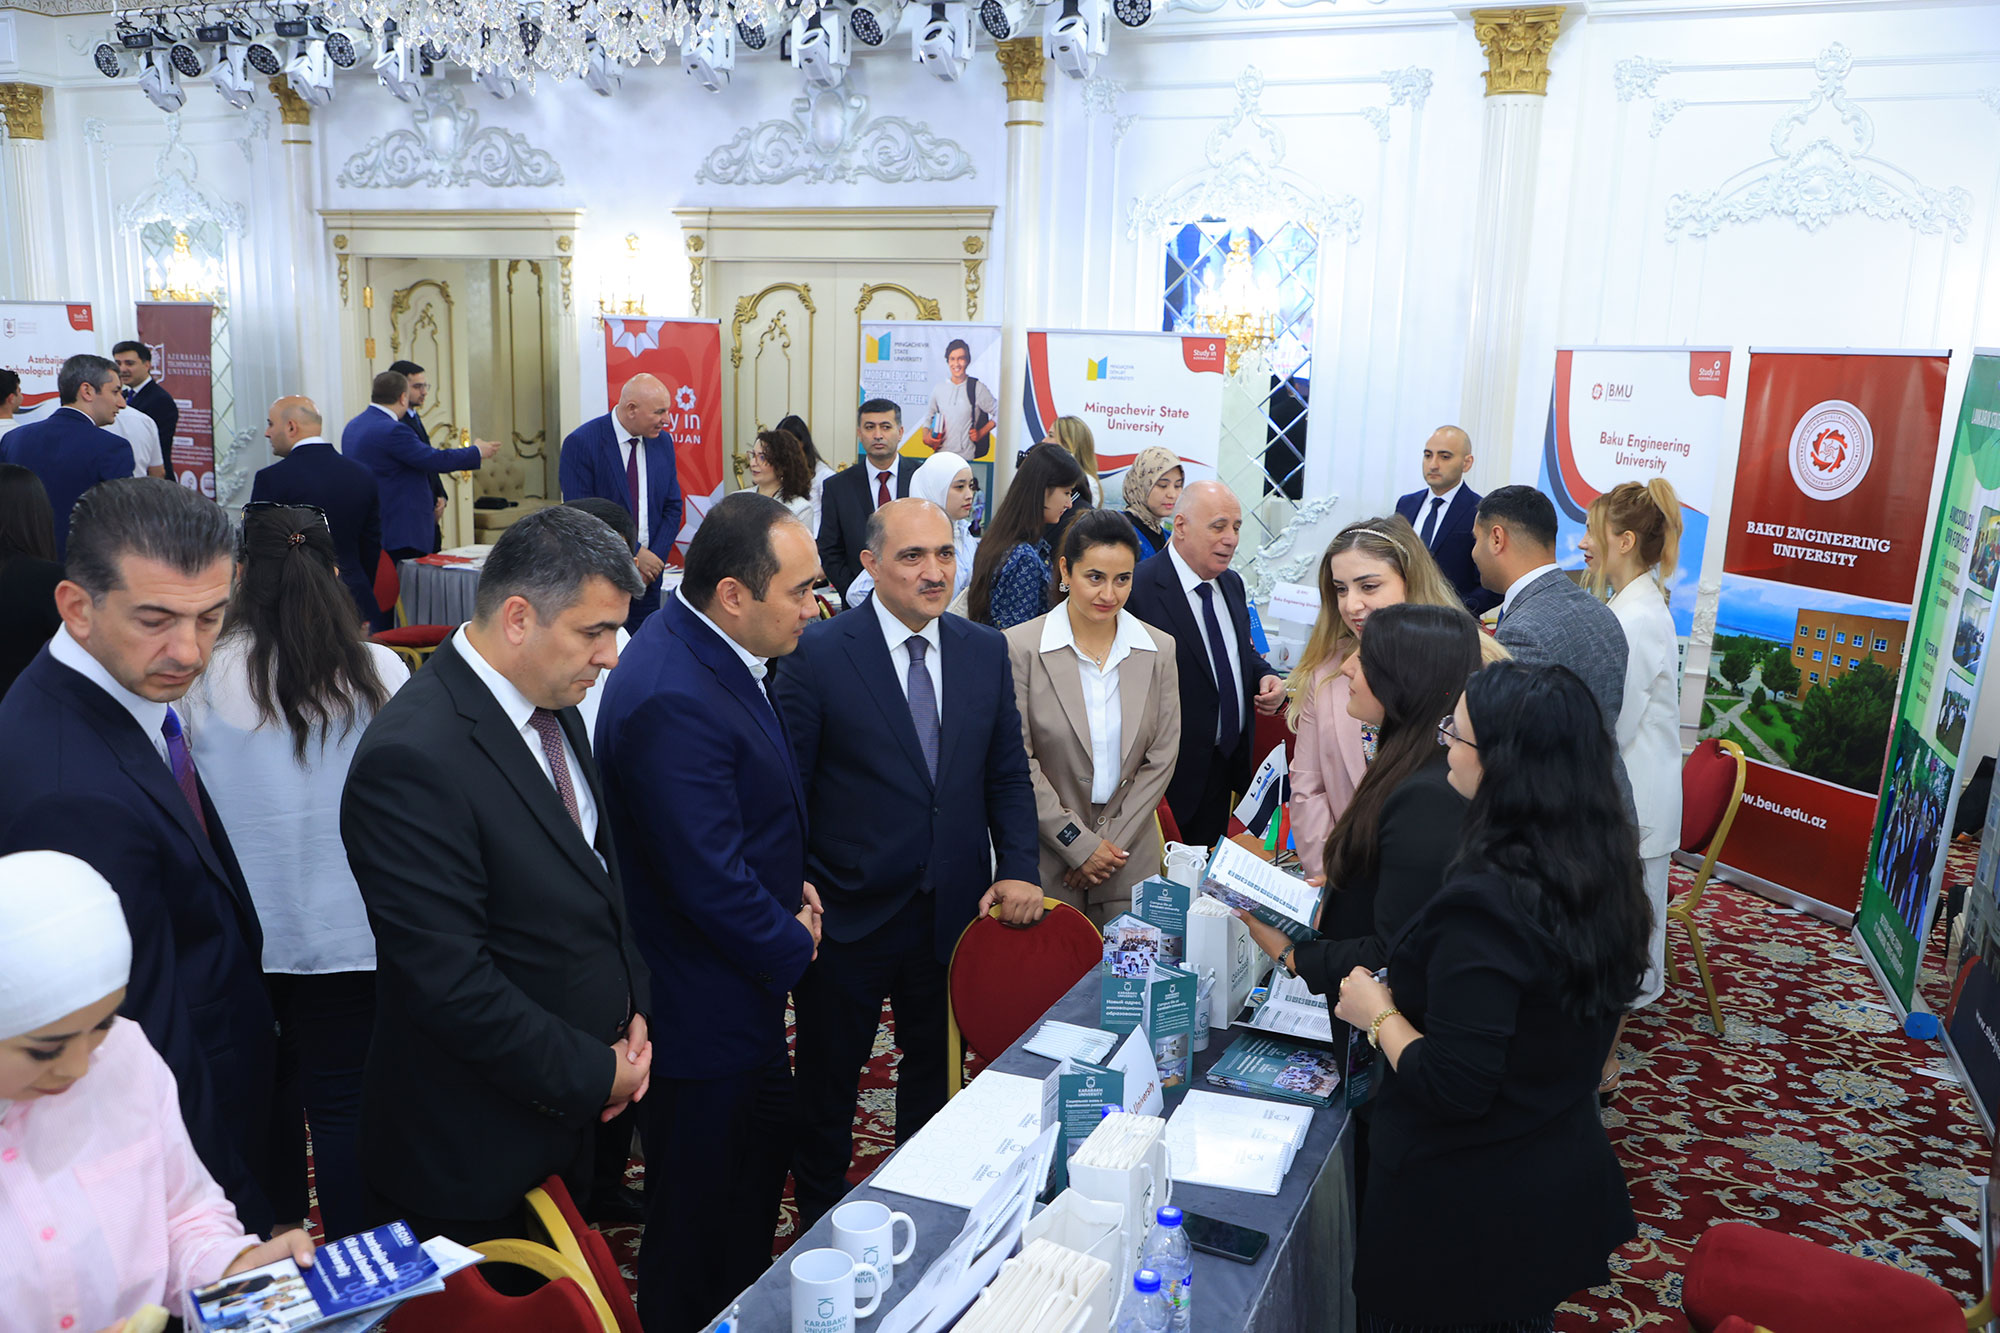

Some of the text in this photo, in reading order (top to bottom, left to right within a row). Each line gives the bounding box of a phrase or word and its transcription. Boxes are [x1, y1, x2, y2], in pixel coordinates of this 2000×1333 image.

[1608, 383, 1633, 398] BMU
[1084, 402, 1189, 419] Mingachevir State
[1107, 418, 1164, 436] University
[1600, 431, 1691, 457] Baku Engineering
[1615, 451, 1667, 473] University
[1746, 521, 1891, 553] BAKU ENGINEERING
[1773, 543, 1858, 567] UNIVERSITY
[1740, 792, 1827, 829] w.beu.edu.az
[804, 1314, 848, 1328] KARABAKH
[804, 1323, 847, 1333] UNIVERSITY
